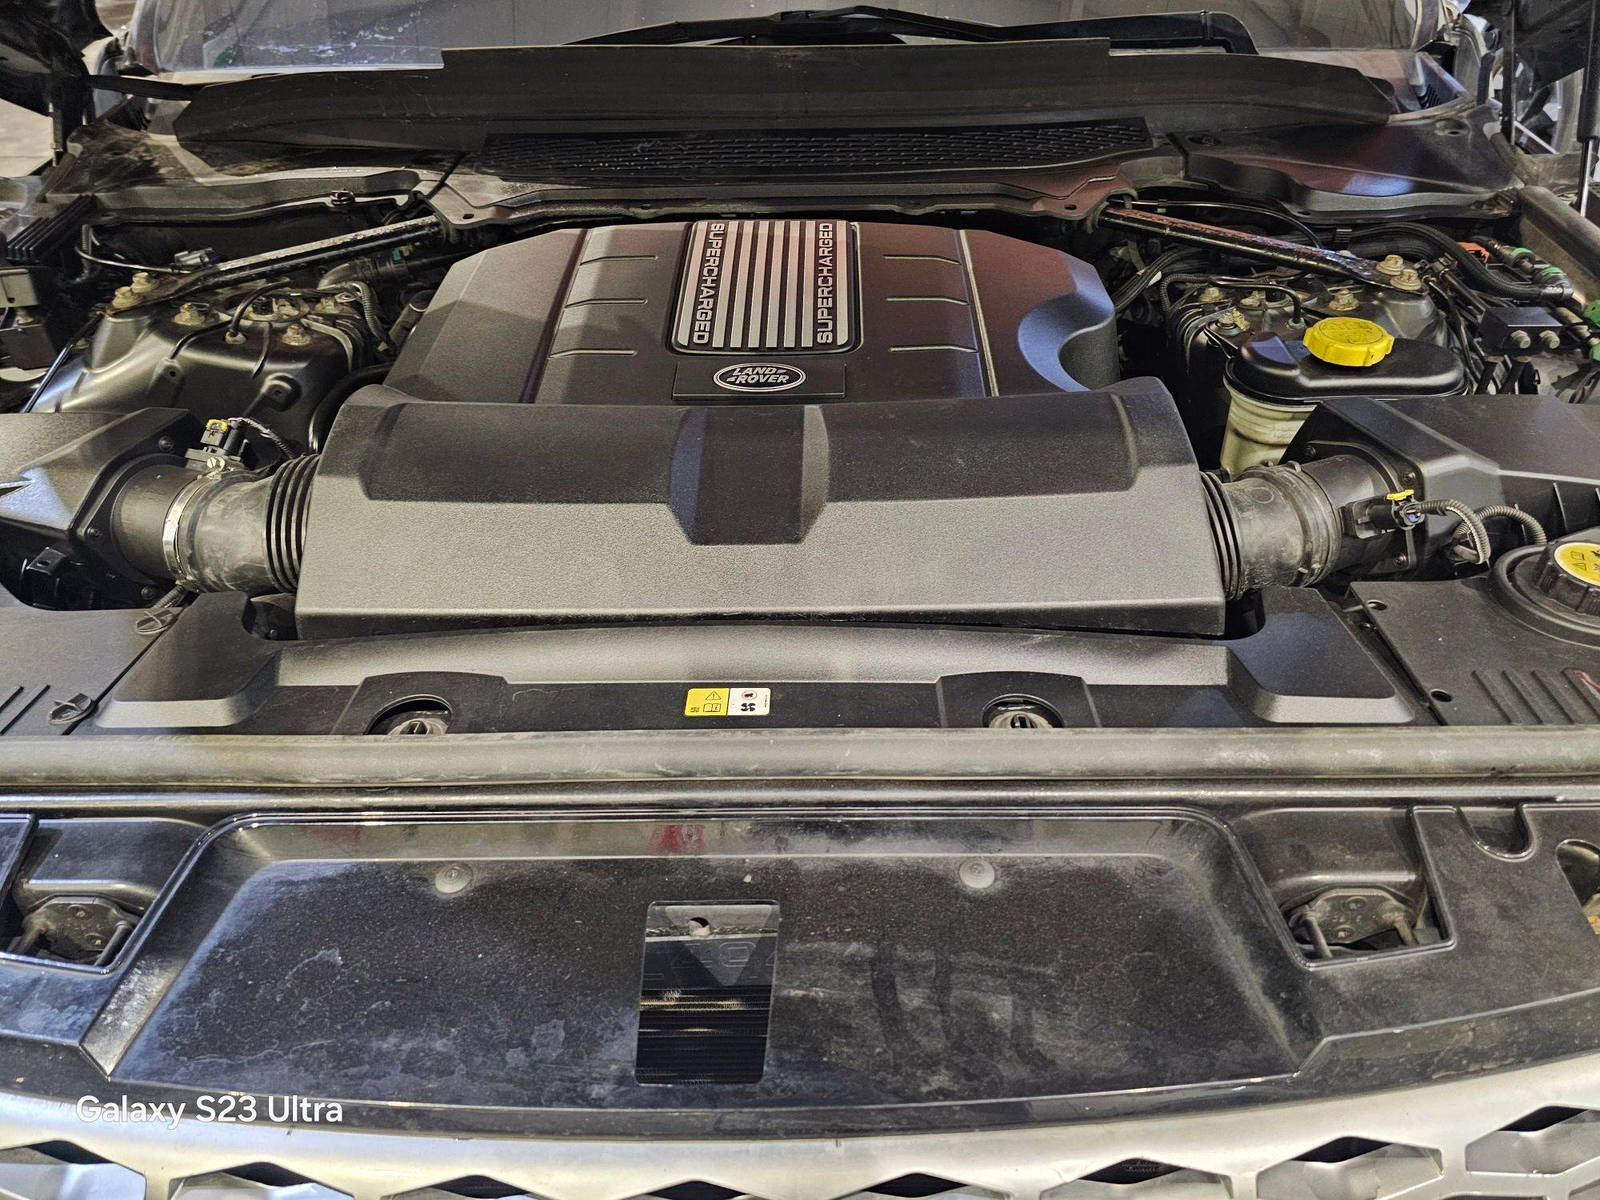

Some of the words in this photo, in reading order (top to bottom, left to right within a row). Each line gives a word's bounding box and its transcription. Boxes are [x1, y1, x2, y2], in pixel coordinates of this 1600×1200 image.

[693, 223, 725, 344] SUPERCHARGED
[817, 223, 833, 343] SUPERCHARGED
[734, 367, 776, 376] LAND
[737, 374, 789, 384] ROVER
